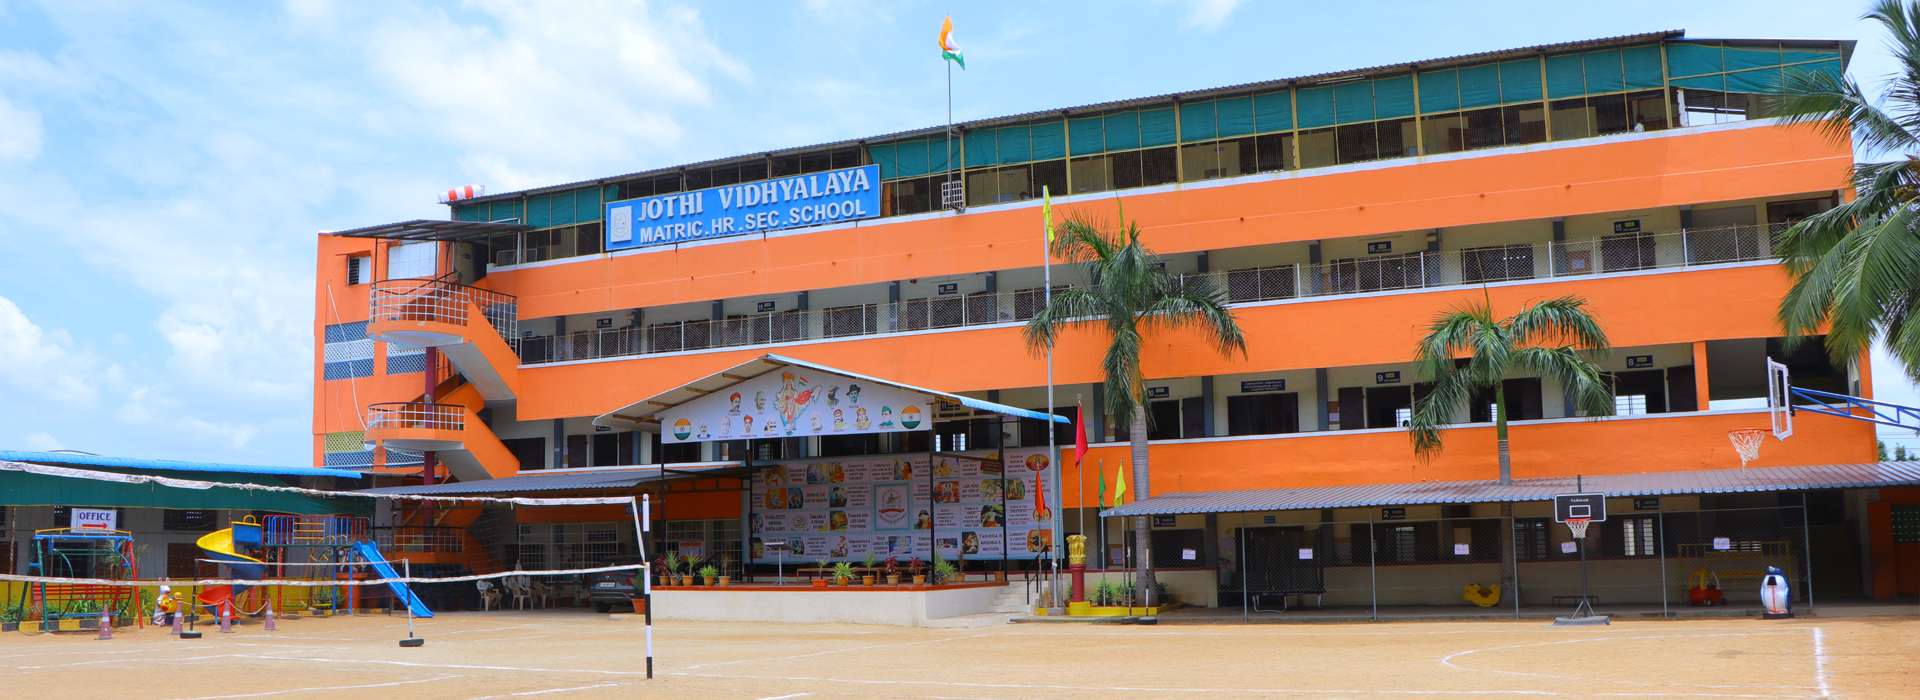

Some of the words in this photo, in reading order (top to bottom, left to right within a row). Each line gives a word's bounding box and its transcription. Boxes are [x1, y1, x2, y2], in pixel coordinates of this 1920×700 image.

[637, 192, 704, 222] JOTHI
[718, 168, 871, 210] VIDHYALAYA
[790, 199, 867, 225] SCHOOL
[79, 511, 112, 521] OFFICE
